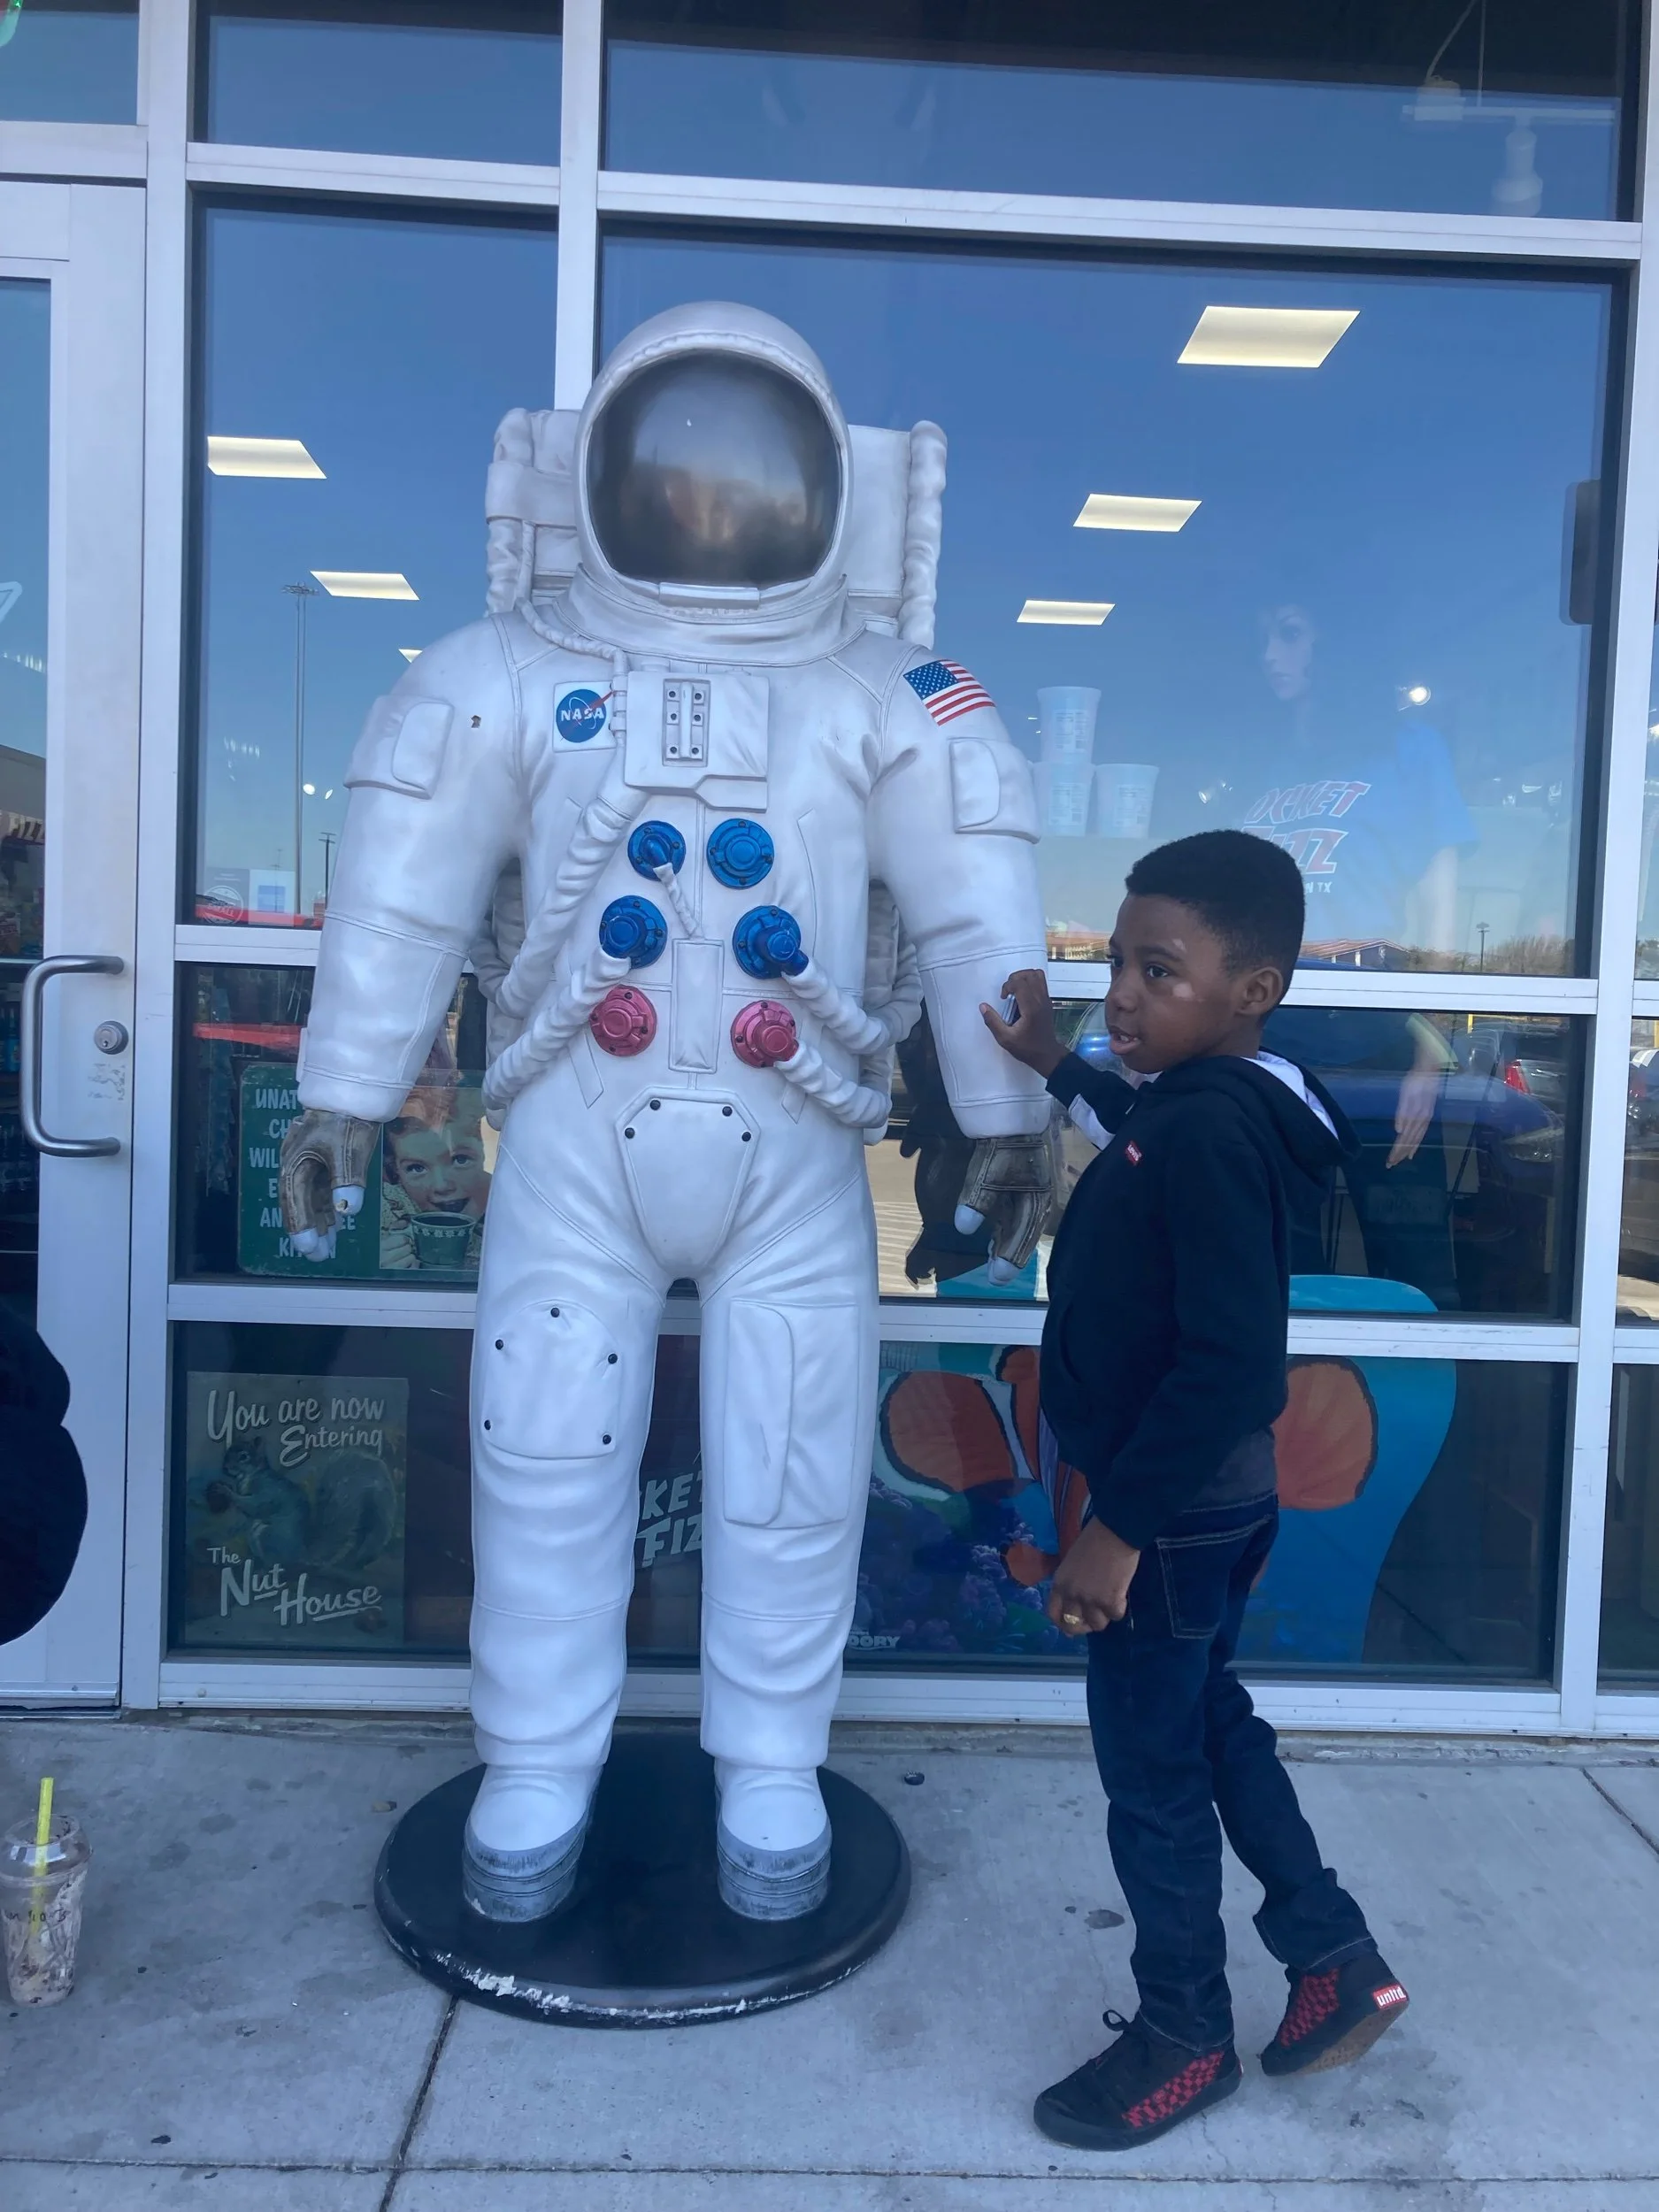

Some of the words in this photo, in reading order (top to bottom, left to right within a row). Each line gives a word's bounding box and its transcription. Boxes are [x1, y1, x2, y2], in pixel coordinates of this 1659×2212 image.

[560, 707, 605, 722] NASA
[1243, 780, 1372, 825] OCKET
[1317, 881, 1333, 893] TX
[255, 1088, 298, 1110] UNAT
[249, 1147, 280, 1169] WIL
[259, 1207, 283, 1228] AN
[207, 1390, 269, 1448] You
[278, 1398, 321, 1423] are
[331, 1397, 384, 1421] now
[279, 1425, 383, 1467] Entering
[639, 1471, 703, 1520] KE
[206, 1546, 242, 1564] The
[635, 1513, 703, 1569] FIZ
[220, 1558, 288, 1617] Nut
[273, 1572, 383, 1626] House
